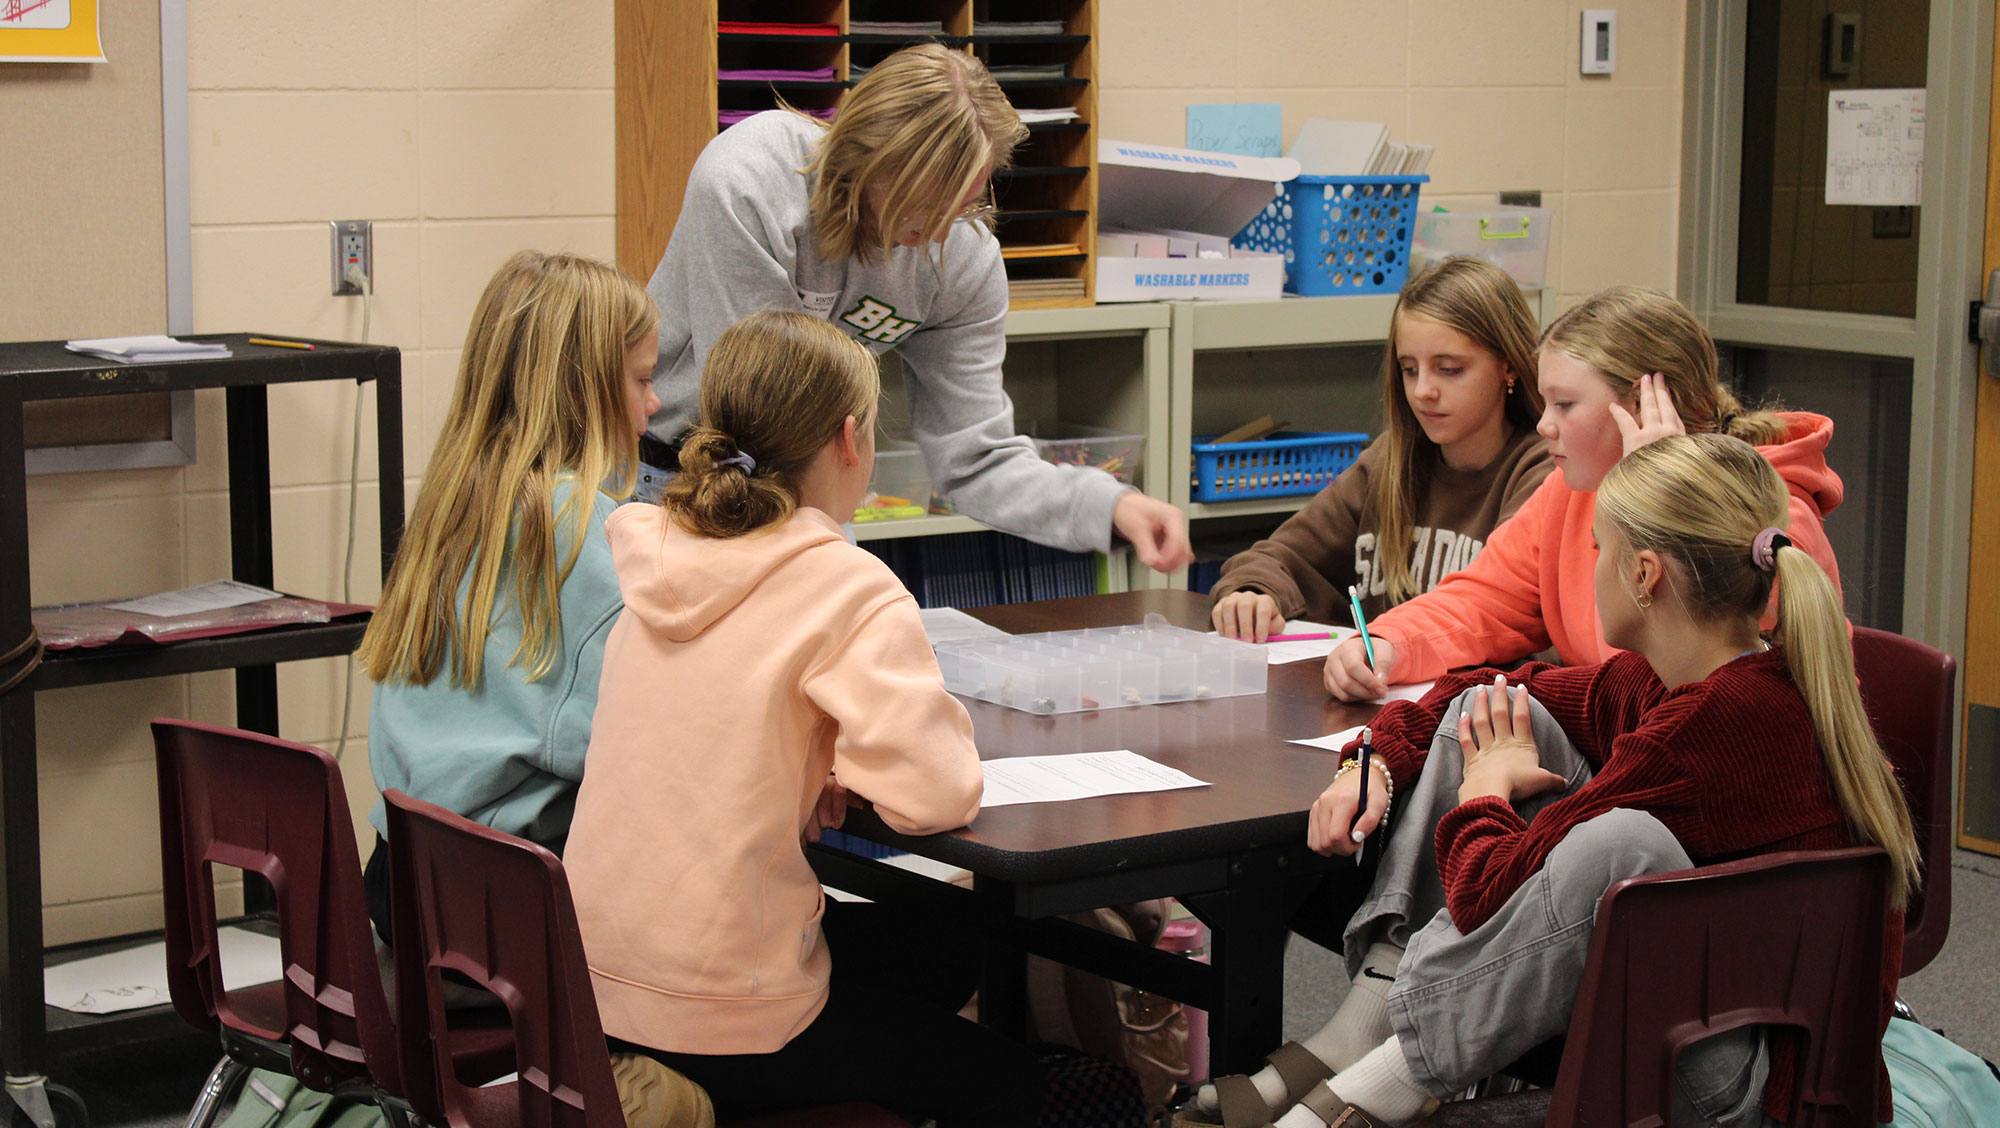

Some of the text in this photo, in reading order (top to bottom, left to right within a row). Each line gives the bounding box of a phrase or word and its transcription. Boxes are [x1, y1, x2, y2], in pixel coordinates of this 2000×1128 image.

[1116, 147, 1238, 169] WASHABLE MARKERS
[1134, 272, 1250, 287] WASHABLE MARKERS
[839, 294, 922, 344] BH
